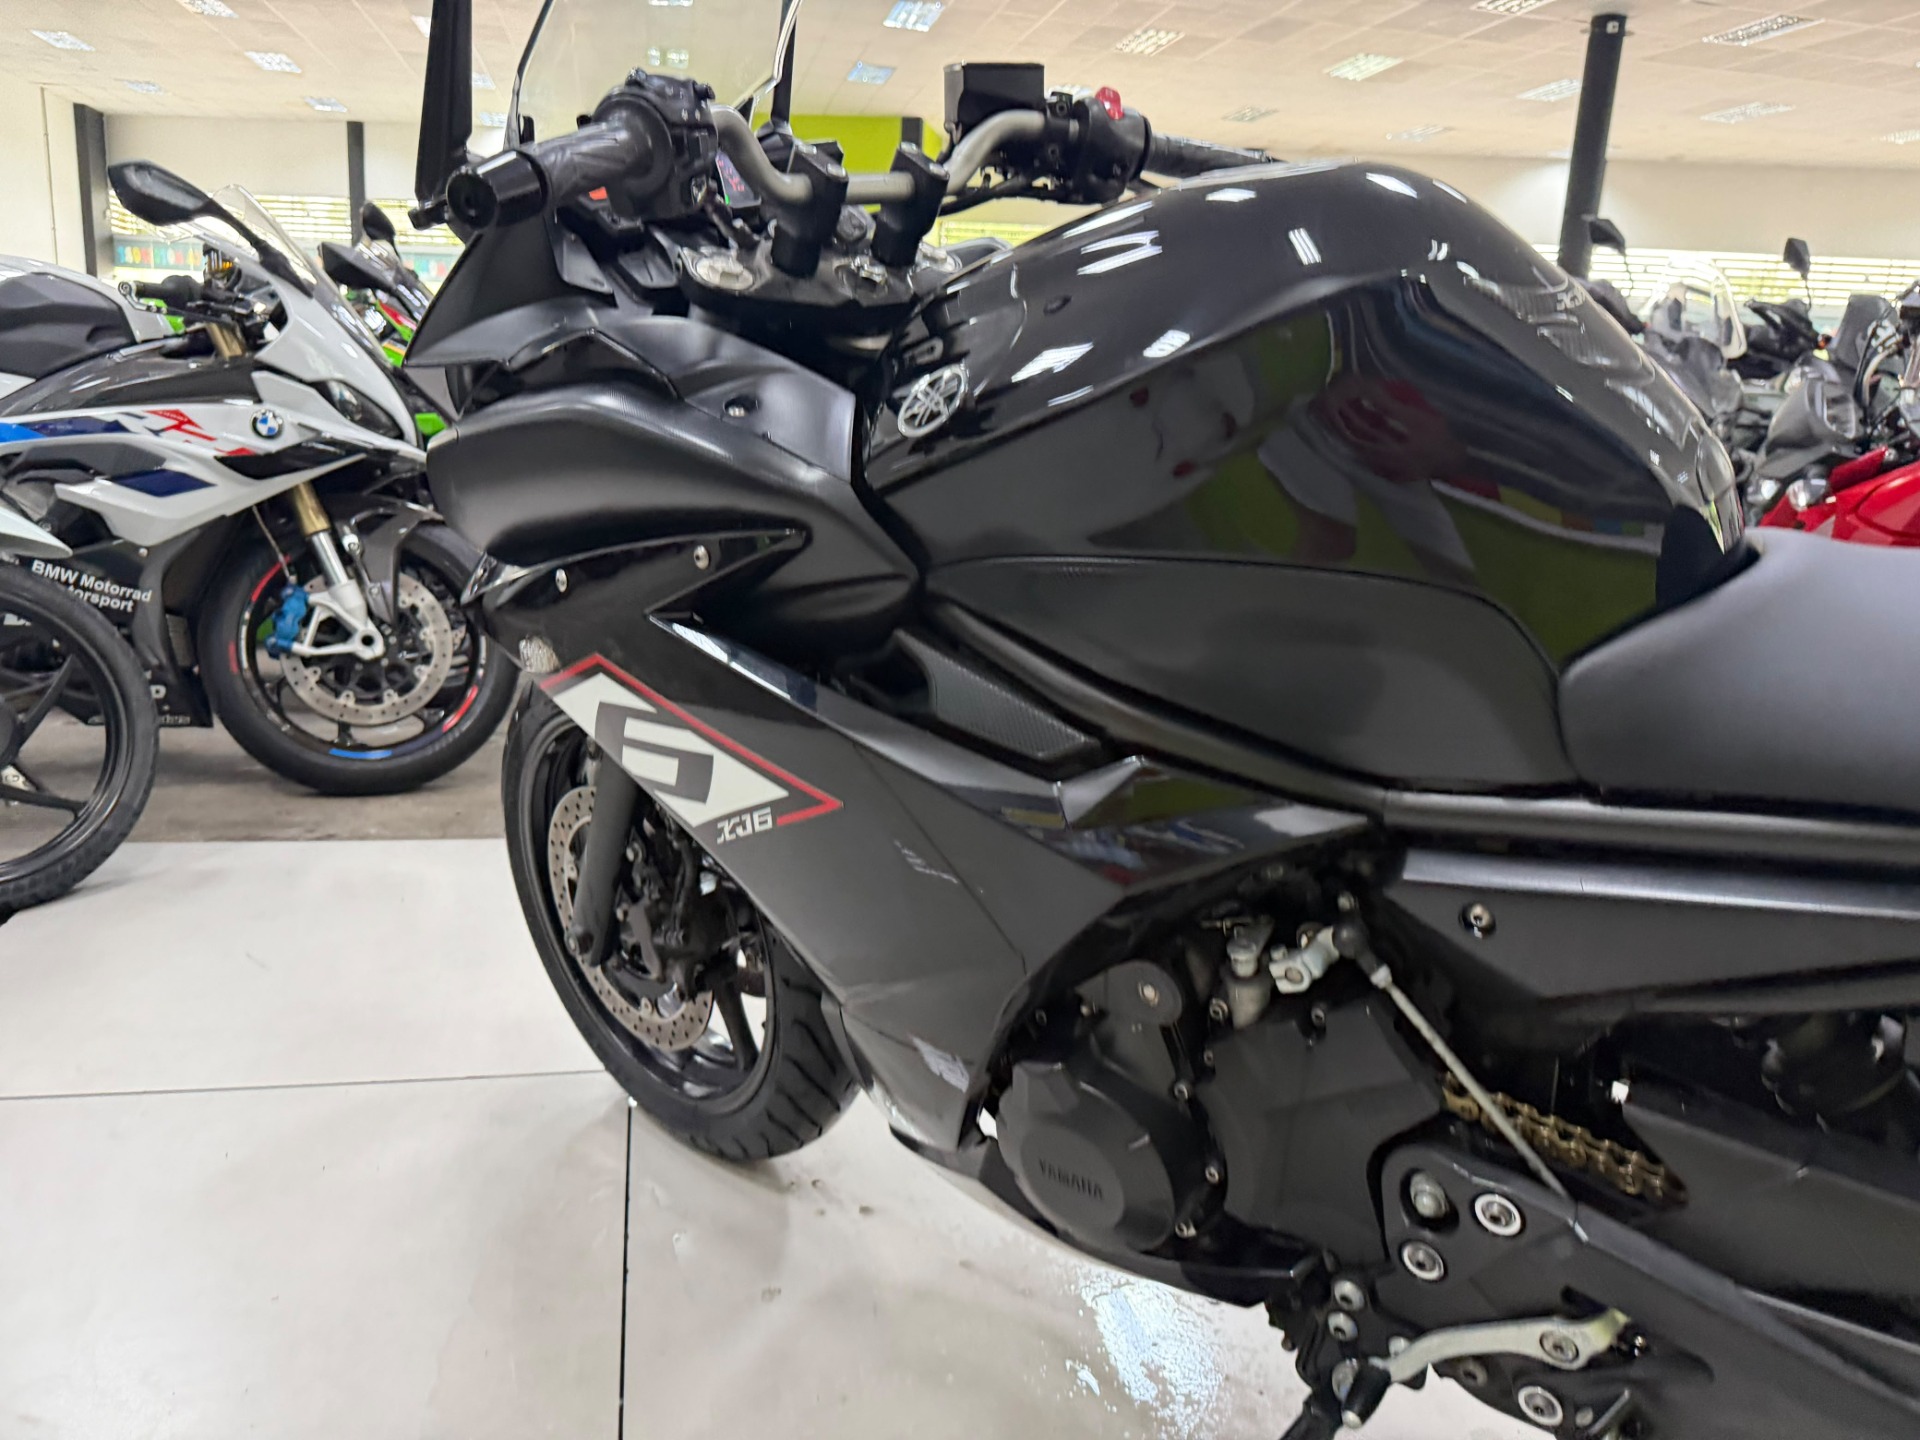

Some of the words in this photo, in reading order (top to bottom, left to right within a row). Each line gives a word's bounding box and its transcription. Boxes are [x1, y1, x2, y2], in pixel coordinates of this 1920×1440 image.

[31, 559, 79, 584] BMW
[80, 573, 152, 602] Motorrad
[716, 807, 773, 844] XJ6
[1038, 1157, 1104, 1200] YAMAHA
